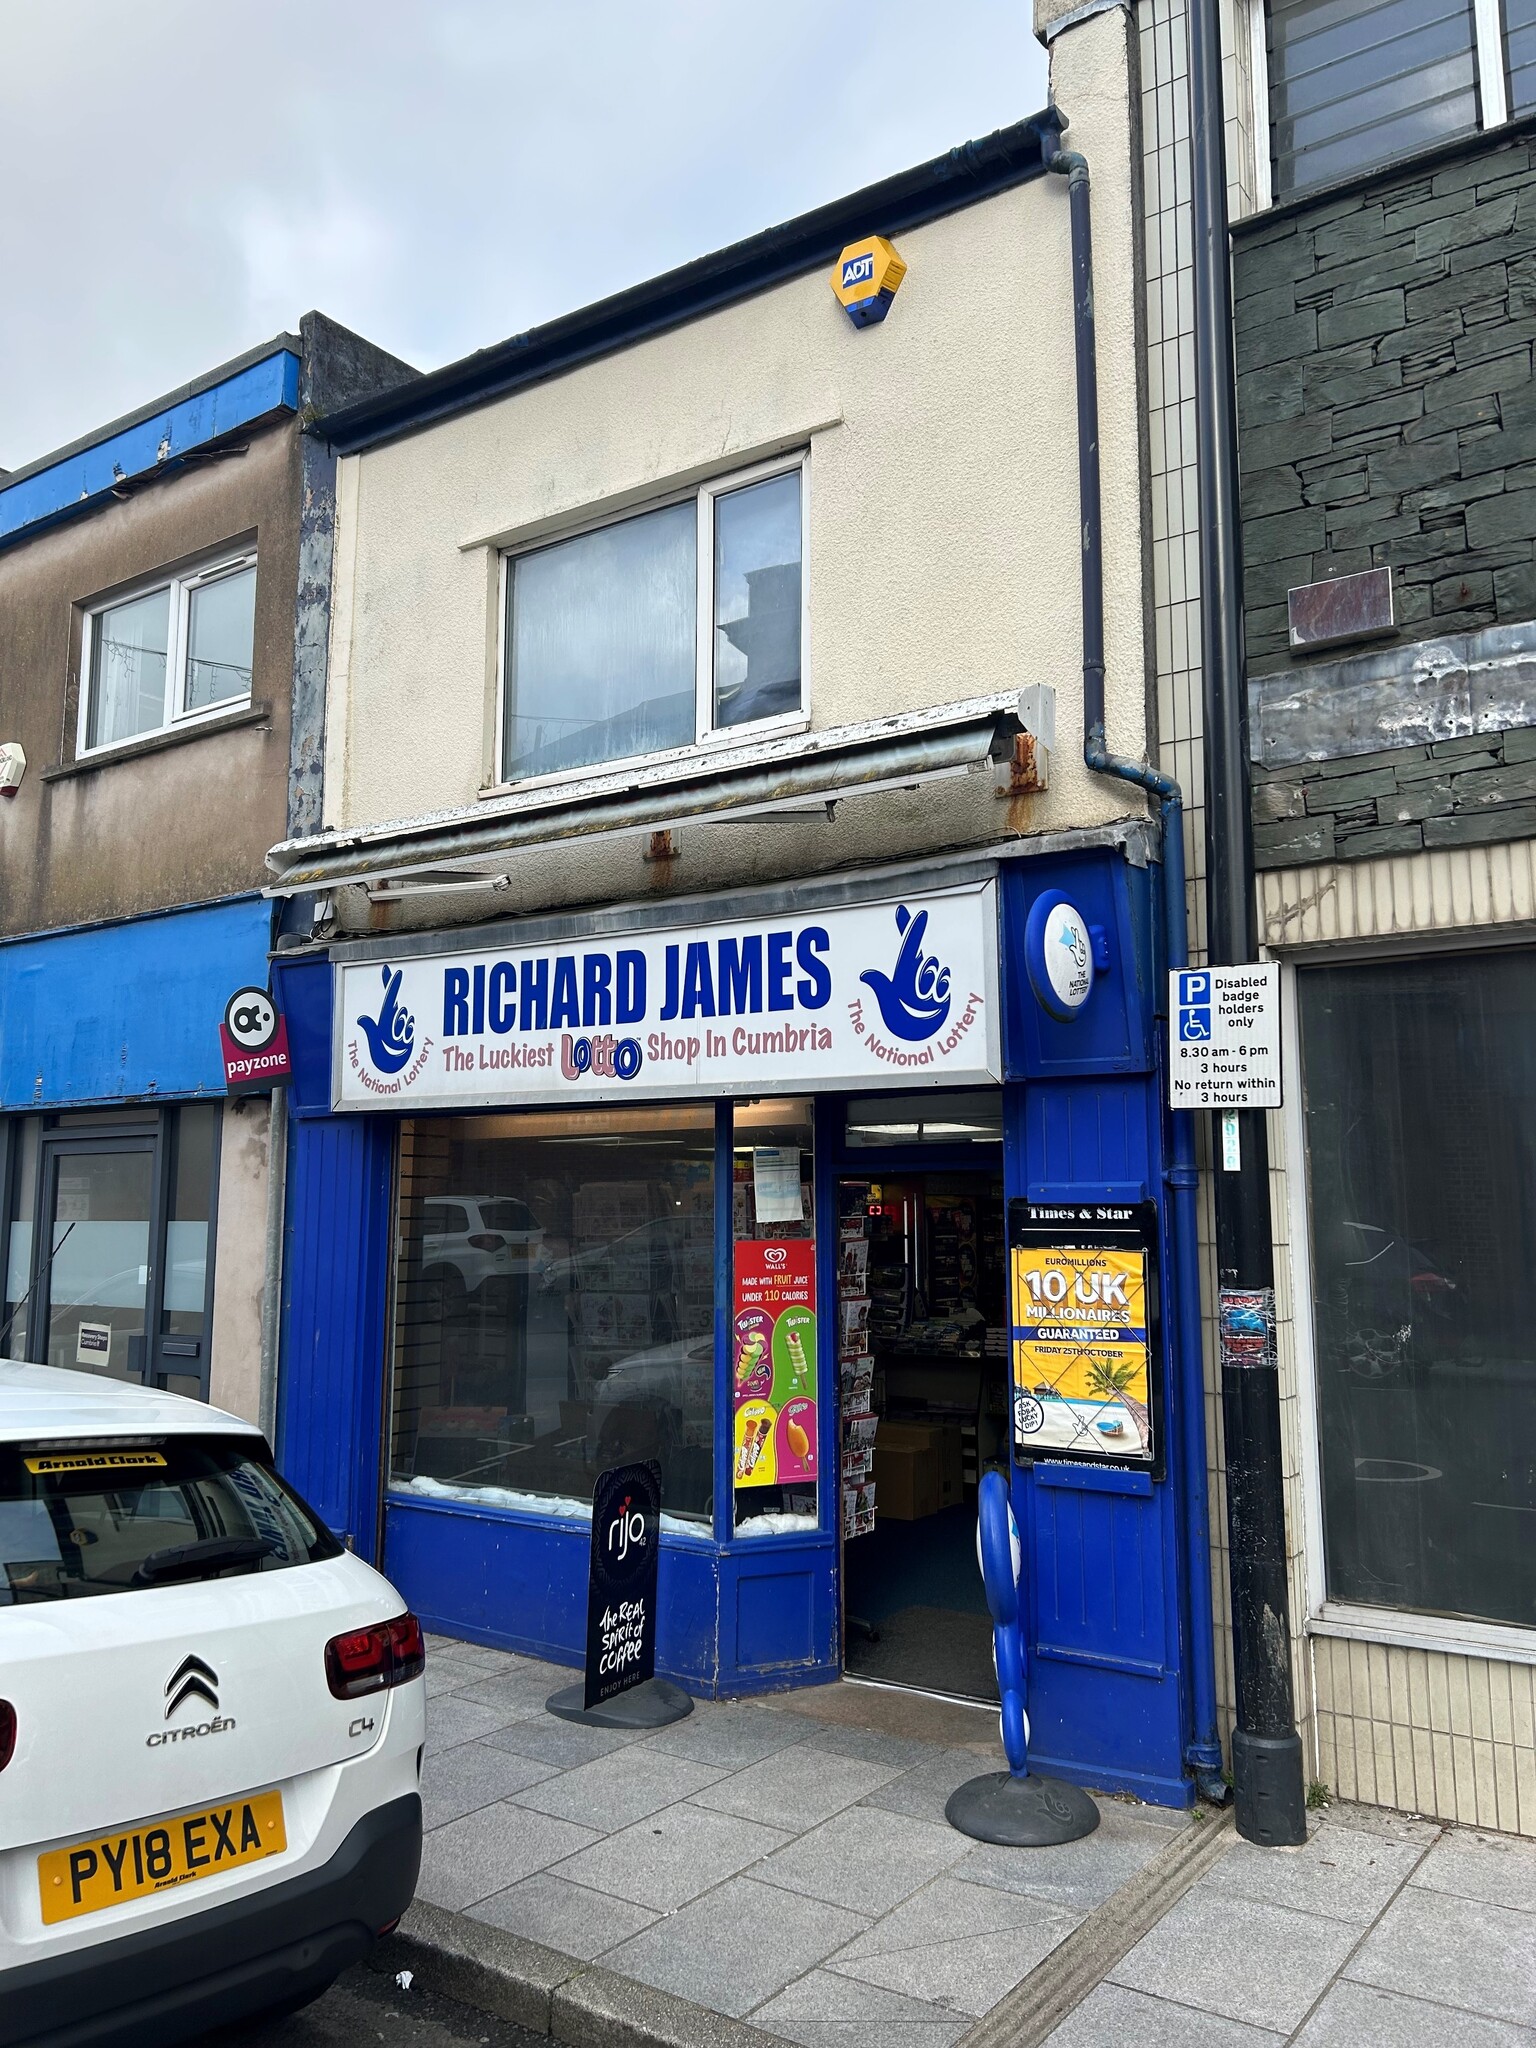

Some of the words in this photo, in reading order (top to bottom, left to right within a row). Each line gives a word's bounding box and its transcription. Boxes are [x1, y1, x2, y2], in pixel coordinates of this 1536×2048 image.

[842, 256, 874, 285] ADT
[443, 949, 647, 1037] RICHARD
[660, 926, 832, 1021] JAMES
[1077, 970, 1086, 979] THE
[1187, 976, 1206, 1002] P
[1215, 976, 1267, 989] Disabled
[1222, 990, 1260, 1002] badge
[1218, 1004, 1264, 1015] holders
[848, 999, 865, 1034] The
[864, 1033, 934, 1066] National
[937, 992, 984, 1055] Lottery
[1228, 1016, 1254, 1028] only
[443, 1045, 474, 1071] The
[479, 1042, 554, 1070] Luckiest
[647, 1032, 700, 1065] Shop
[706, 1029, 726, 1057] In
[732, 1023, 832, 1055] Cumbria
[1180, 1047, 1209, 1058] 8.30
[1211, 1048, 1229, 1057] am
[1239, 1046, 1247, 1056] 6
[1249, 1047, 1268, 1057] pm
[227, 1053, 287, 1078] payzone
[348, 1040, 359, 1068] The
[357, 1067, 401, 1094] National
[403, 1037, 434, 1086] Lottery
[1201, 1063, 1208, 1073] 3
[1213, 1063, 1247, 1073] hours
[1174, 1080, 1191, 1090] No
[1195, 1080, 1233, 1090] return
[1237, 1078, 1276, 1089] within
[1201, 1092, 1209, 1102] 3
[1213, 1092, 1248, 1102] hours
[1028, 1206, 1075, 1220] Times
[1079, 1208, 1092, 1219] &
[1096, 1207, 1133, 1220] Star
[1045, 1258, 1107, 1267] EUROMILLIONS
[742, 1277, 757, 1286] MADE
[760, 1277, 772, 1285] WITH
[774, 1275, 792, 1285] FRUIT
[794, 1276, 808, 1285] JUICE
[1025, 1270, 1067, 1303] 10
[1075, 1271, 1130, 1306] UK
[742, 1292, 762, 1302] UNDER
[765, 1290, 779, 1301] 110
[782, 1291, 808, 1301] CALORIES
[1026, 1304, 1130, 1323] MILLIONAIRES
[1037, 1327, 1119, 1341] GUARANTEED
[1035, 1346, 1061, 1354] FRIDAY
[1063, 1347, 1083, 1356] 25TH
[1083, 1348, 1123, 1358] OCTOBER
[1018, 1400, 1031, 1409] ASK
[38, 1457, 107, 1470] Arnold
[109, 1456, 158, 1465] Clark
[608, 1497, 645, 1560] rijo
[599, 1605, 617, 1632] The
[634, 1615, 645, 1637] of
[600, 1679, 621, 1697] ENJOY
[624, 1671, 641, 1686] HERE
[349, 1717, 374, 1737] C4
[70, 1828, 172, 1904] PY18
[182, 1804, 262, 1869] EXA
